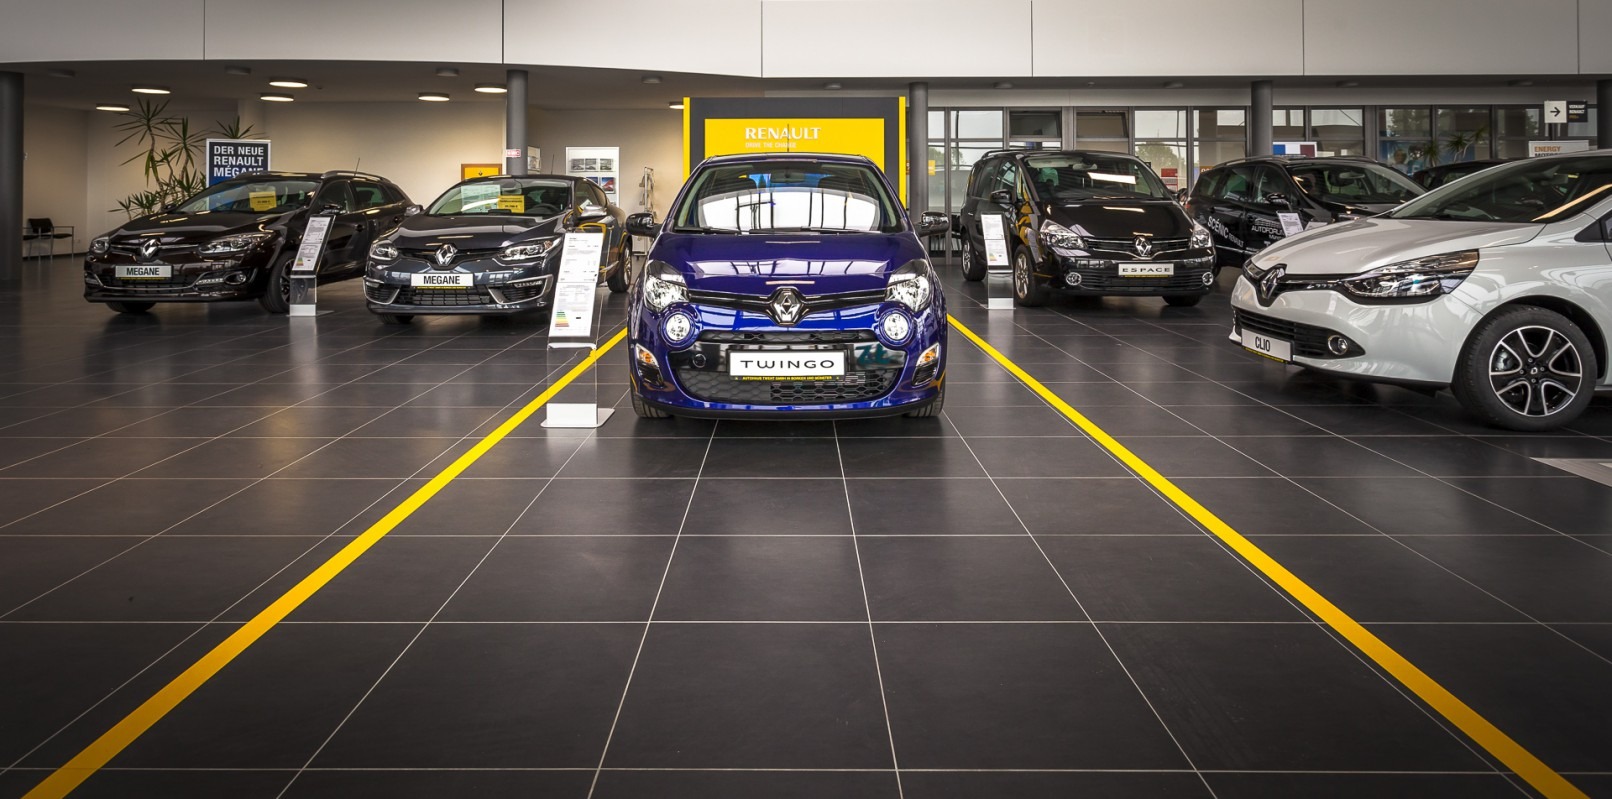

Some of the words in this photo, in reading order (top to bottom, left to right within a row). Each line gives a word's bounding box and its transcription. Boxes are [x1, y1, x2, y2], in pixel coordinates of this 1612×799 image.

[745, 127, 821, 140] RENAULT
[763, 141, 773, 149] THE
[213, 145, 234, 155] DER
[237, 146, 264, 156] NEUE
[213, 155, 264, 166] RENAULT
[126, 267, 160, 276] MEGANE
[423, 275, 461, 285] MEGANE
[1255, 336, 1271, 352] CLIO
[740, 360, 835, 369] TWINGO
